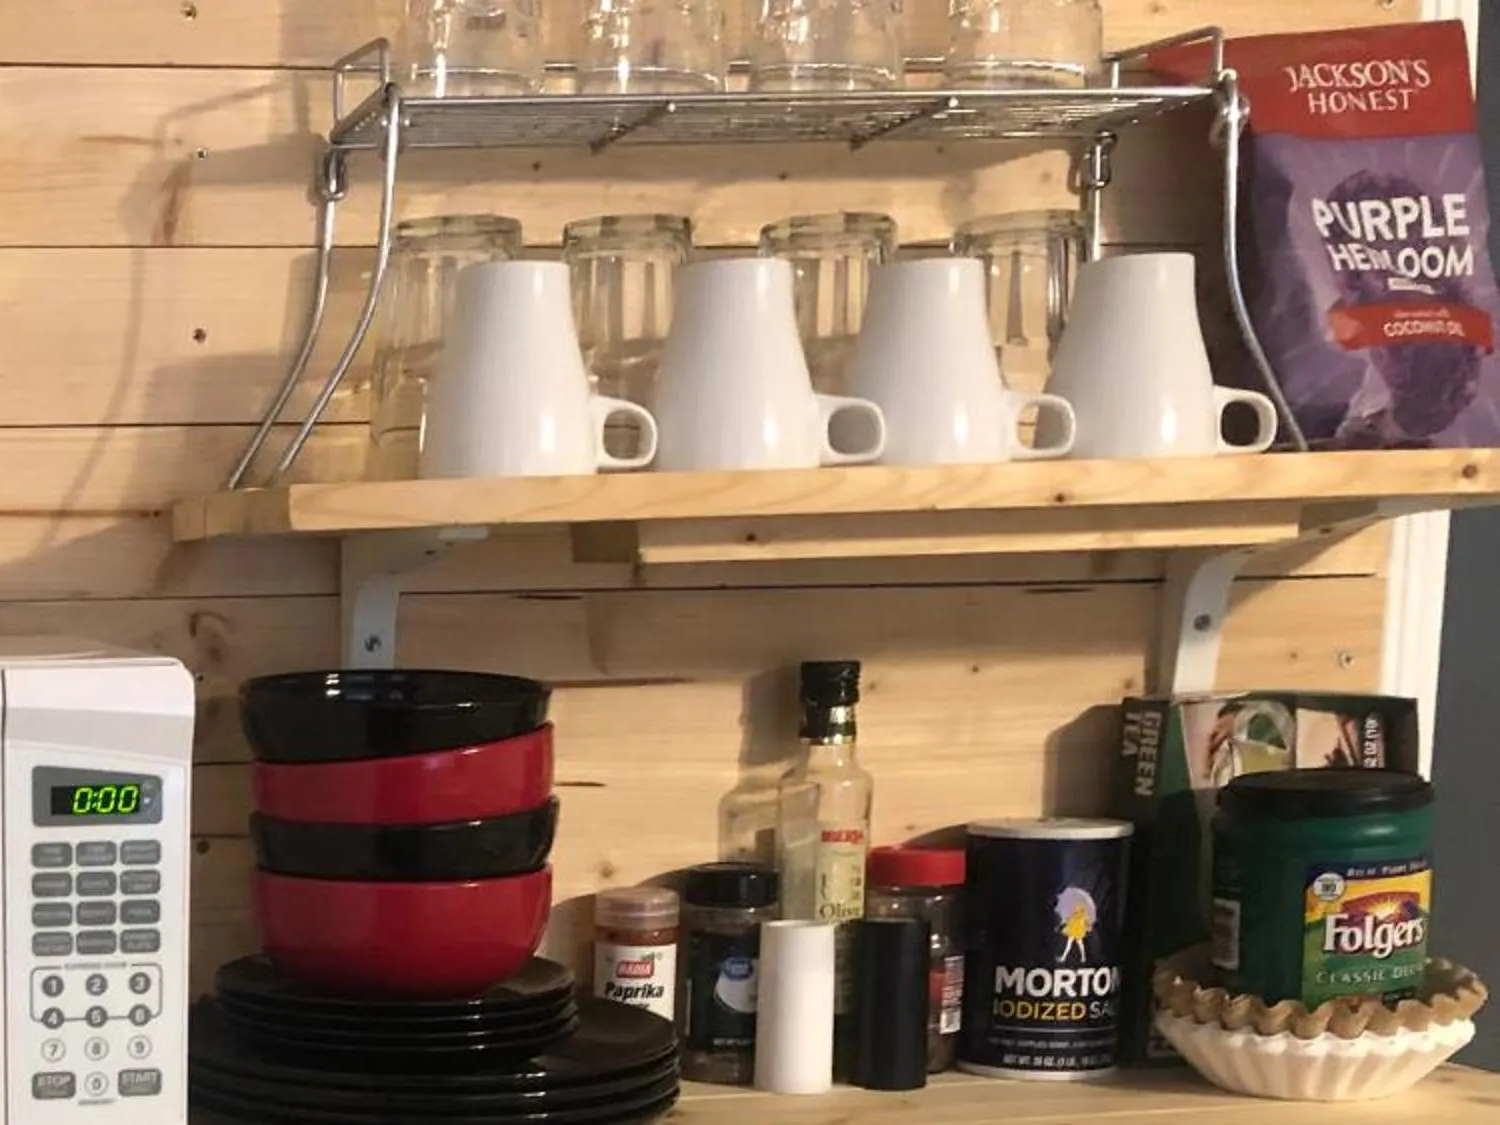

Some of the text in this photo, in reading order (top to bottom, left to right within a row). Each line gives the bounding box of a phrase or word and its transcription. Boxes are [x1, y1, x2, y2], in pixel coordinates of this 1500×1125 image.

[1284, 59, 1431, 93] JACKSON'S
[1307, 88, 1413, 115] HONEST
[1311, 192, 1470, 242] PURPLE
[1121, 711, 1141, 757] TEA
[1134, 711, 1162, 796] GREEN
[72, 785, 139, 814] 0:00
[1323, 912, 1424, 959] Folgers
[604, 982, 665, 1001] Paprika
[993, 999, 1088, 1021] IODIZED
